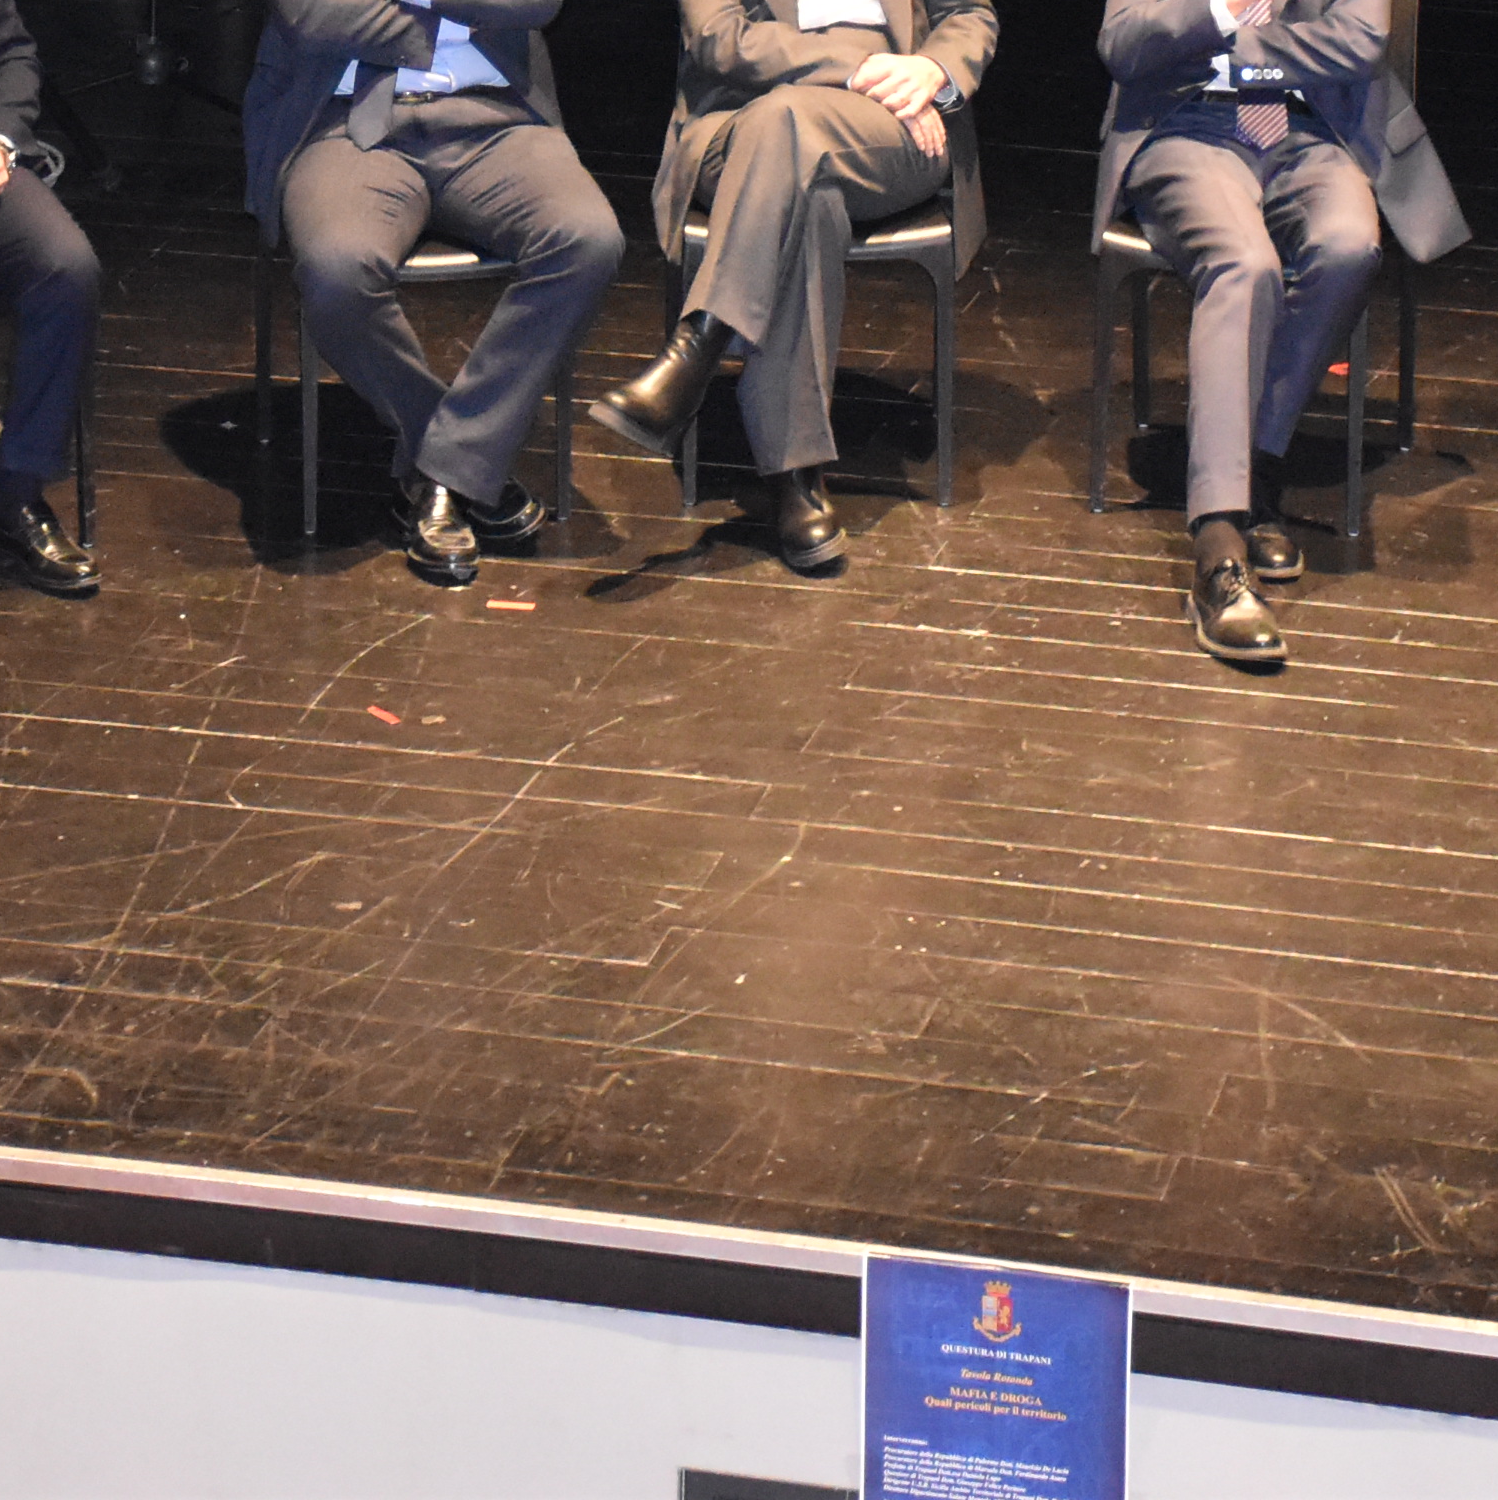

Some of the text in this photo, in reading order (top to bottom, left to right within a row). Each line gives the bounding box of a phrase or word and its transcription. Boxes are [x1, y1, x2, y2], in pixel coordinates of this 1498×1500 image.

[941, 1344, 1052, 1365] QUESTURA DI TRAPANI
[961, 1368, 1033, 1386] Tavola Rotonda
[950, 1387, 1042, 1406] MAFIA E DROGA
[925, 1396, 1067, 1421] Quali pericoli per il territorio
